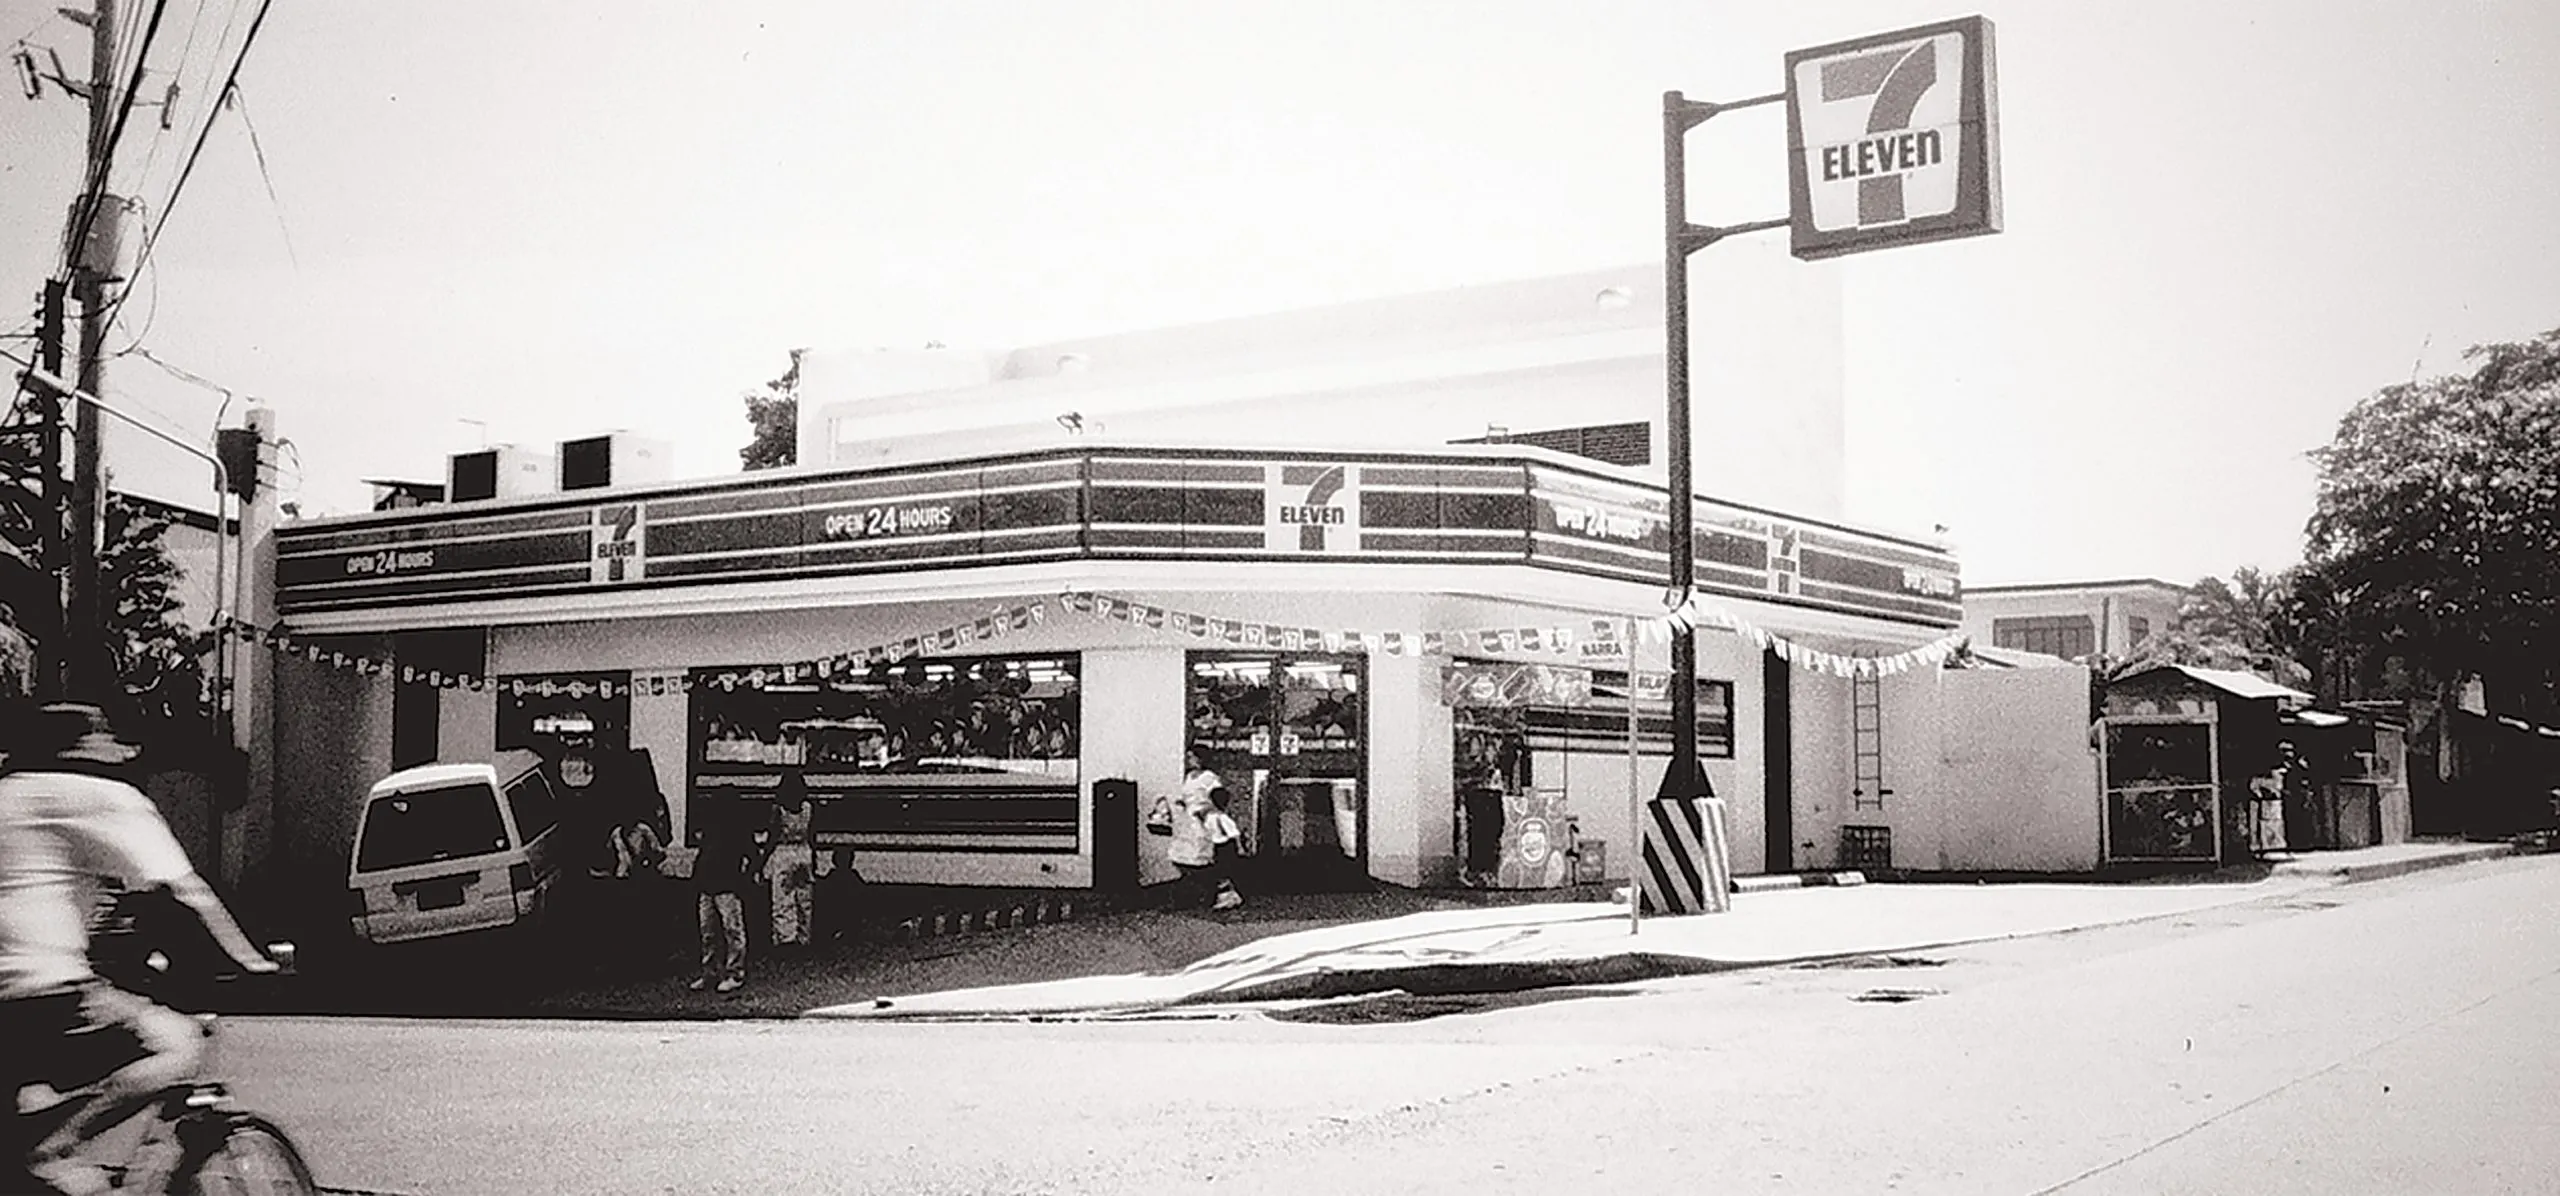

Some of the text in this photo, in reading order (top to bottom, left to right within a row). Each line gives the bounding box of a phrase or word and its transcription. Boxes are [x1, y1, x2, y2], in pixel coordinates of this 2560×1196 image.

[1820, 39, 1937, 225] 7
[600, 504, 637, 581] 7
[825, 506, 951, 536] OPEN 24 HOURS
[1282, 465, 1345, 551] 7
[376, 551, 397, 574] 24
